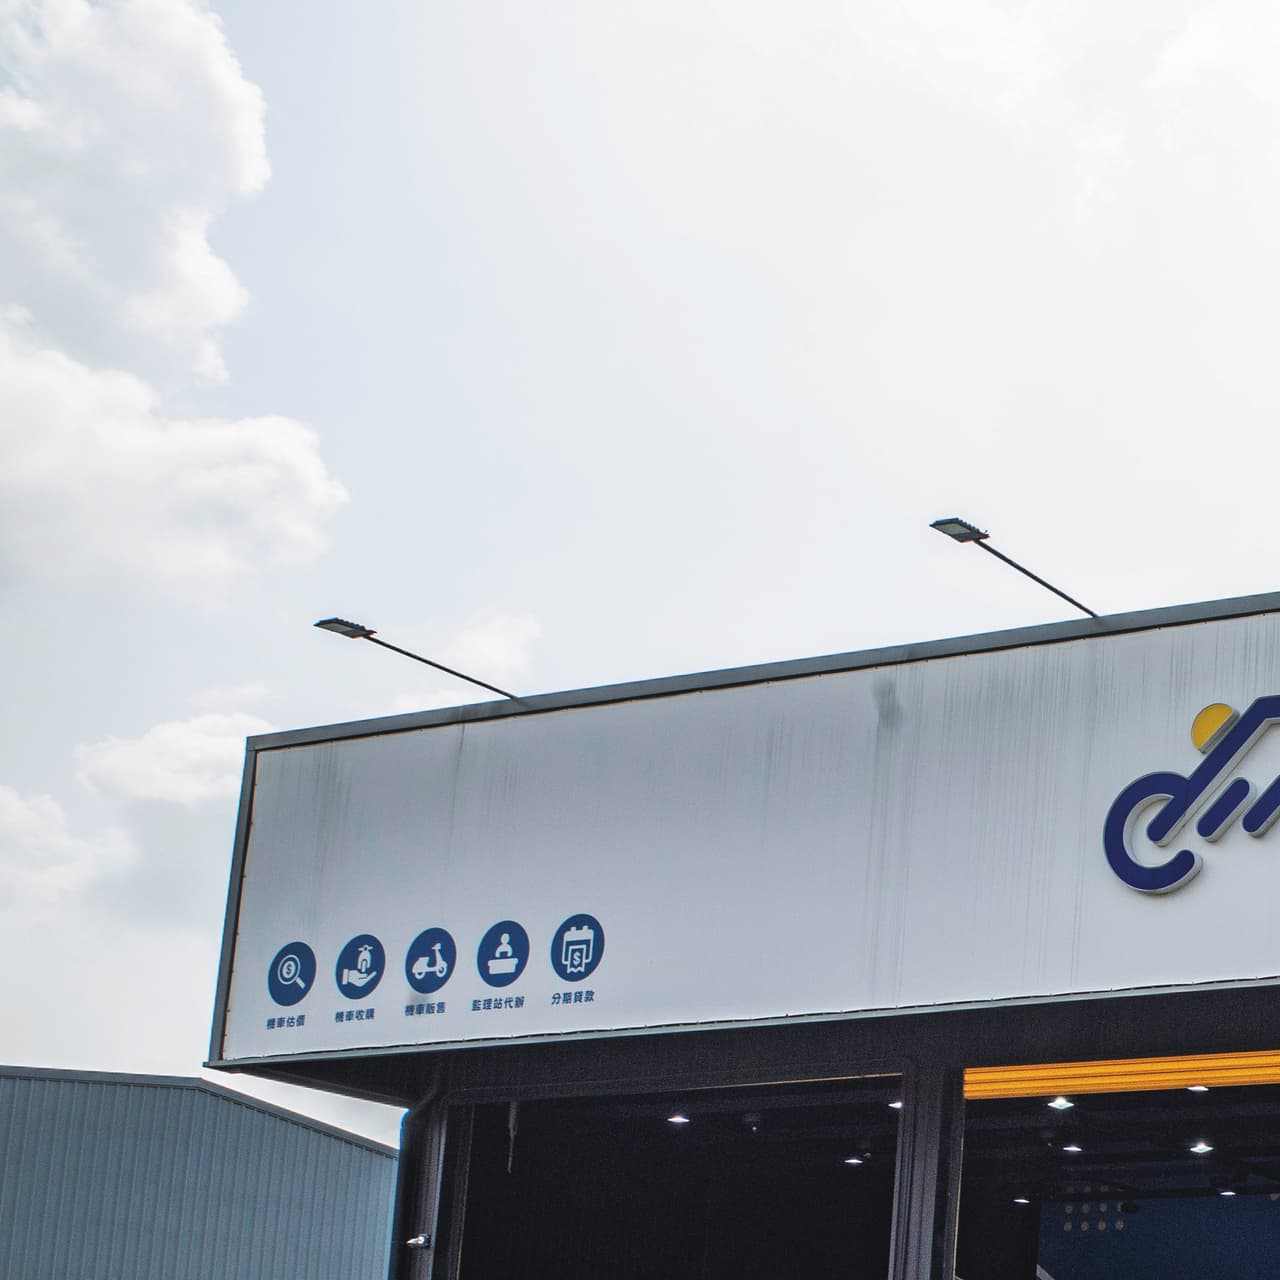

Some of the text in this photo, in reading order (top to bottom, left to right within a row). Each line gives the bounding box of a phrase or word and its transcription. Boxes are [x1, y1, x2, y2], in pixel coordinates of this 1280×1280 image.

[472, 996, 525, 1011] 監理站代辦
[551, 990, 595, 1005] 分期貸款
[404, 1001, 446, 1017] 機車販售
